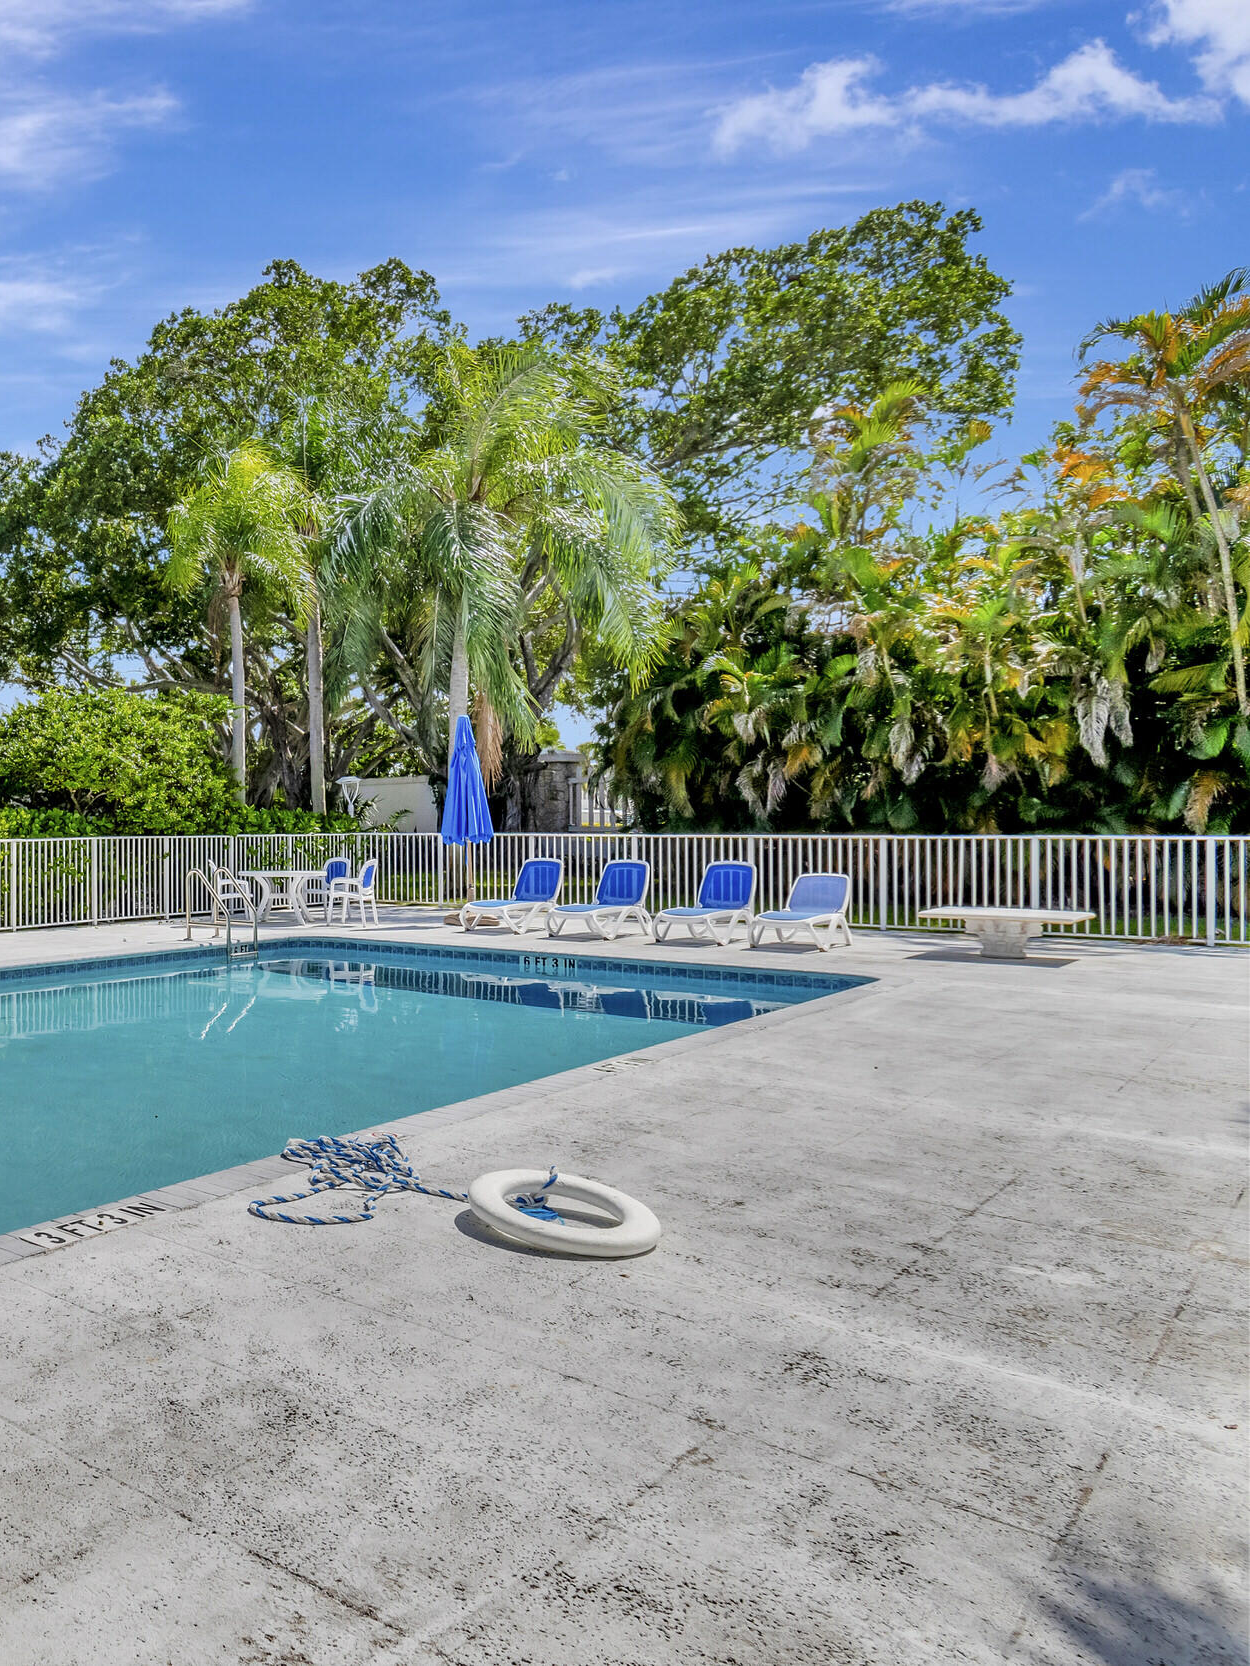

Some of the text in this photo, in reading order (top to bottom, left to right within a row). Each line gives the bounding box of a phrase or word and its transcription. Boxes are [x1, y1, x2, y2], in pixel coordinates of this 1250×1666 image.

[535, 957, 547, 967] FT
[552, 958, 558, 968] 3
[564, 958, 575, 968] IN
[34, 1202, 167, 1244] 3 FT 3 IN
